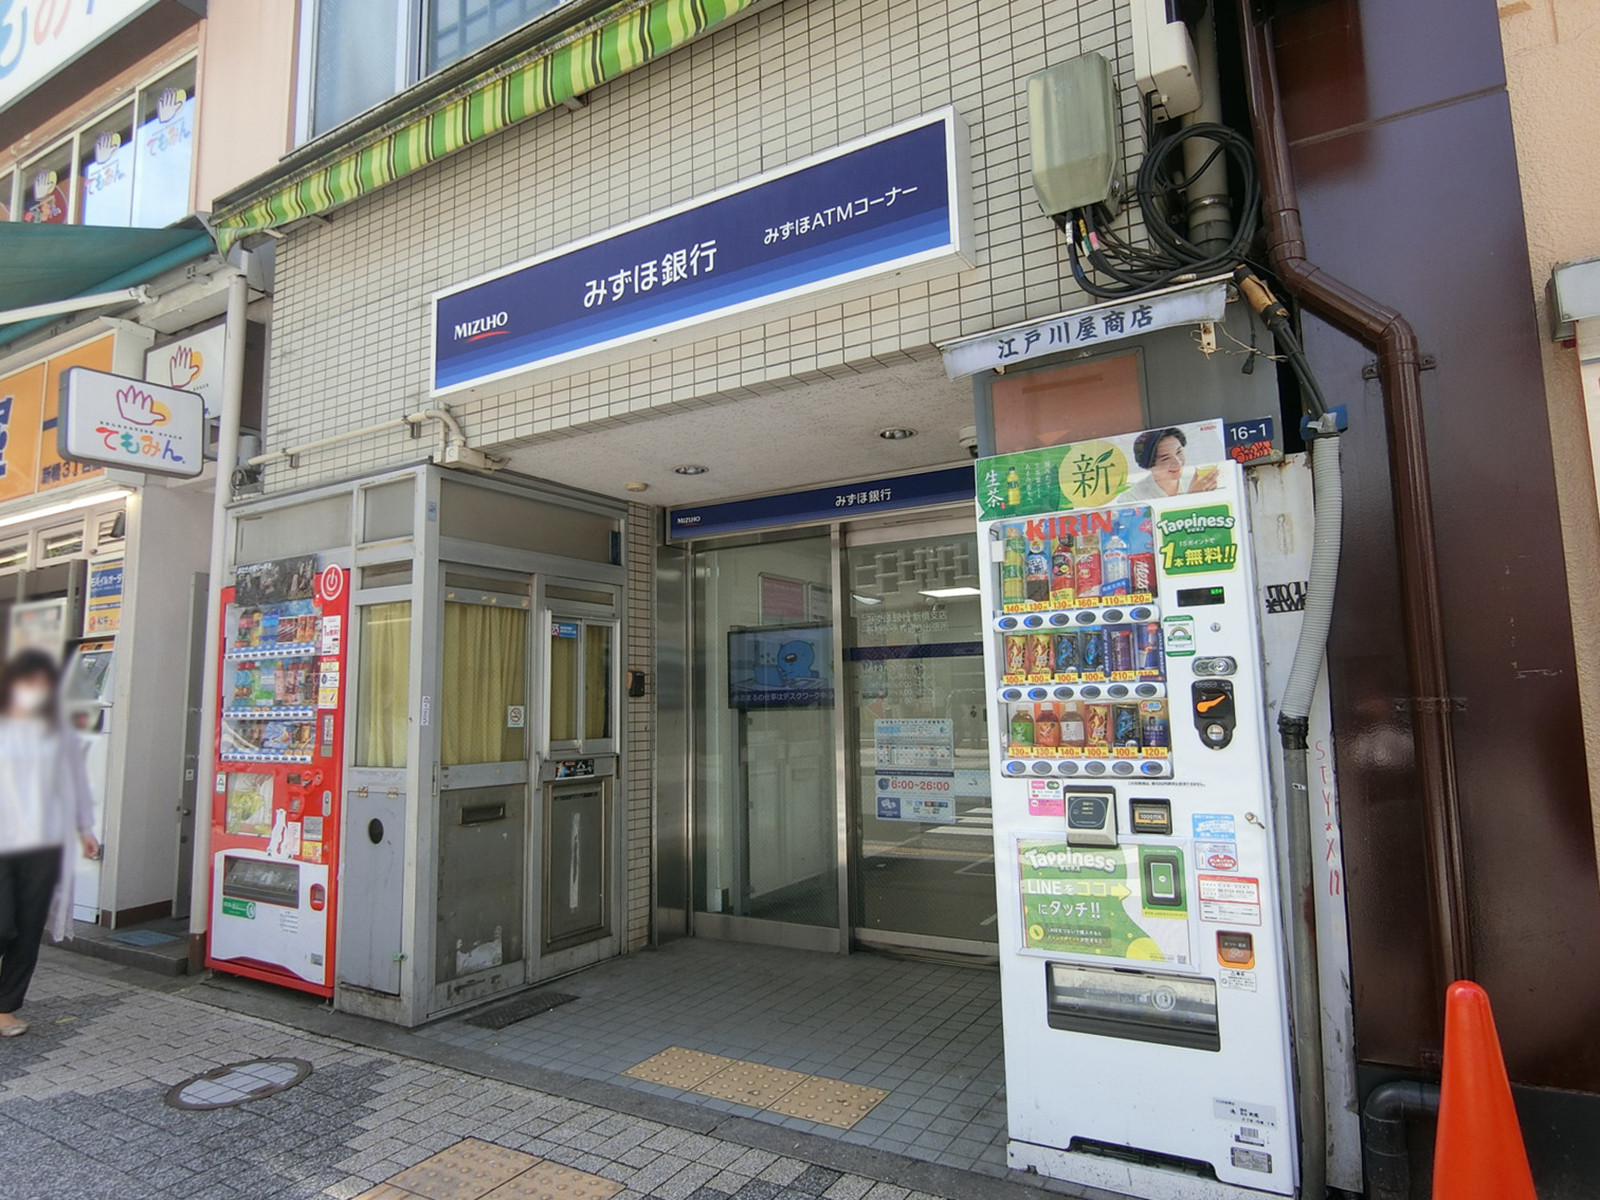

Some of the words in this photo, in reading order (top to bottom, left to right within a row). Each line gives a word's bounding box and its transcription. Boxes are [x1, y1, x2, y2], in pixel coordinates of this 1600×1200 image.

[763, 186, 918, 245] みずほATMコーナー
[583, 240, 717, 308] みずほ銀行
[453, 311, 508, 341] MIZUHO
[997, 304, 1153, 359] 江戸川屋商店
[1230, 423, 1267, 440] 16-1
[985, 469, 1004, 508] 生茶
[1072, 448, 1115, 498] 新
[835, 487, 893, 508] みずほ銀行
[1026, 510, 1112, 541] KIRIN
[1157, 513, 1235, 535] Tappiness
[1025, 847, 1116, 872] Tappiness
